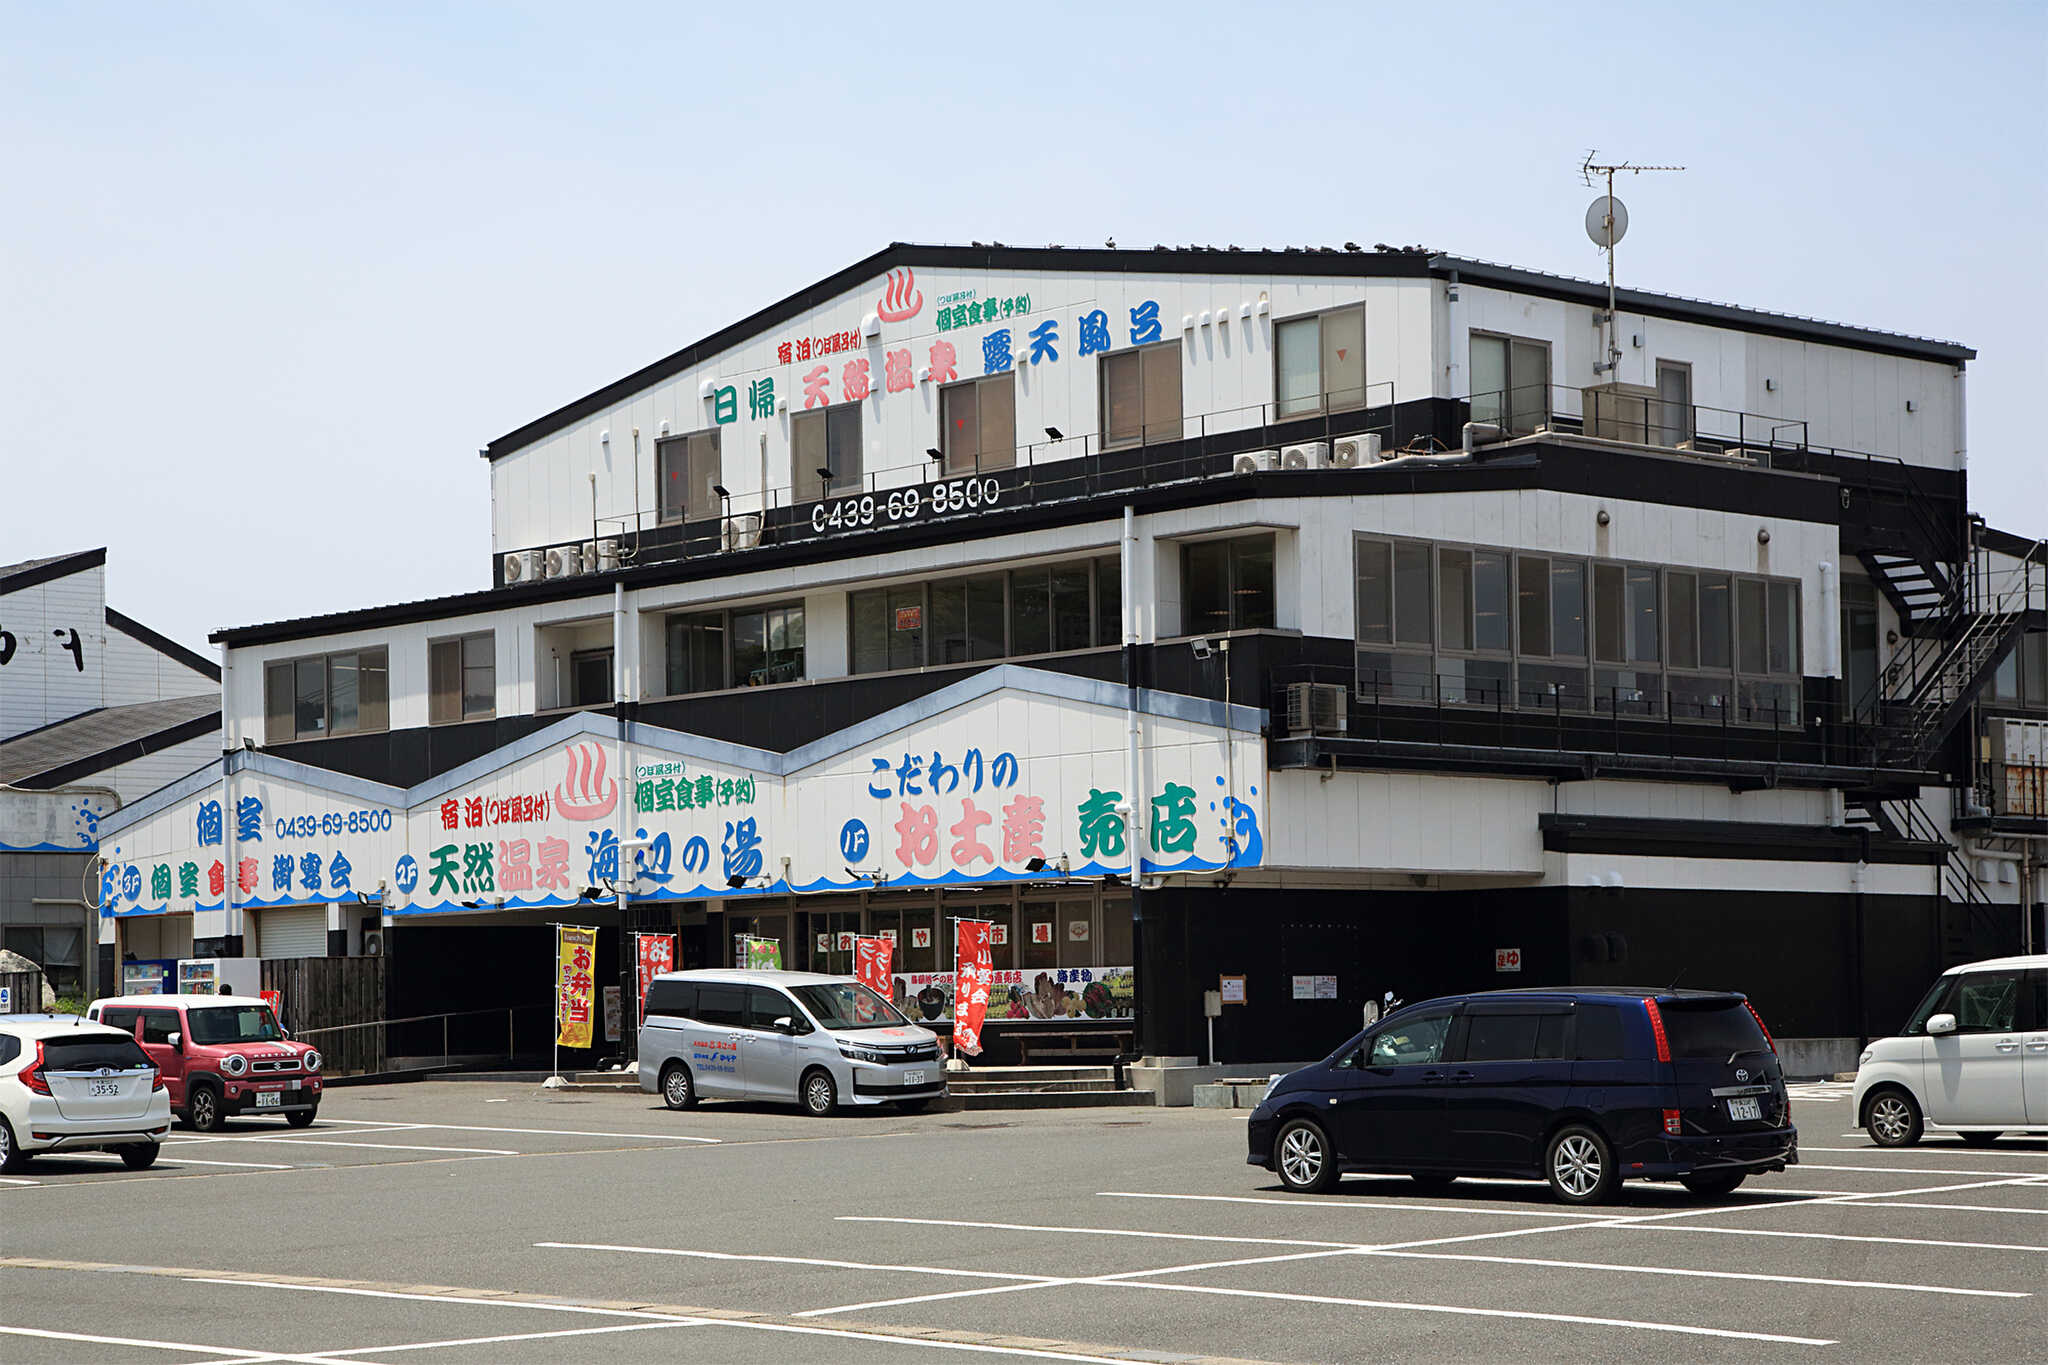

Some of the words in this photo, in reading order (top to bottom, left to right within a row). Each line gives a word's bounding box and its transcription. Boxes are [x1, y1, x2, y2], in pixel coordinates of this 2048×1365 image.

[714, 377, 775, 425] 日帰
[802, 340, 958, 410] 天然温泉
[982, 300, 1162, 374] 露天風呂
[811, 477, 1000, 533] 0439-69-8500
[634, 773, 756, 814] 個室食事(予約)
[868, 749, 1019, 799] こだわりの
[196, 796, 264, 847] 個室
[275, 808, 392, 840] 0439-69-8500
[894, 794, 1047, 867] お土産
[1078, 781, 1197, 859] 売店
[396, 863, 417, 886] 2F
[428, 835, 570, 896] 天然温泉
[584, 816, 763, 886] 海辺の湯
[569, 945, 592, 1023] お弁当
